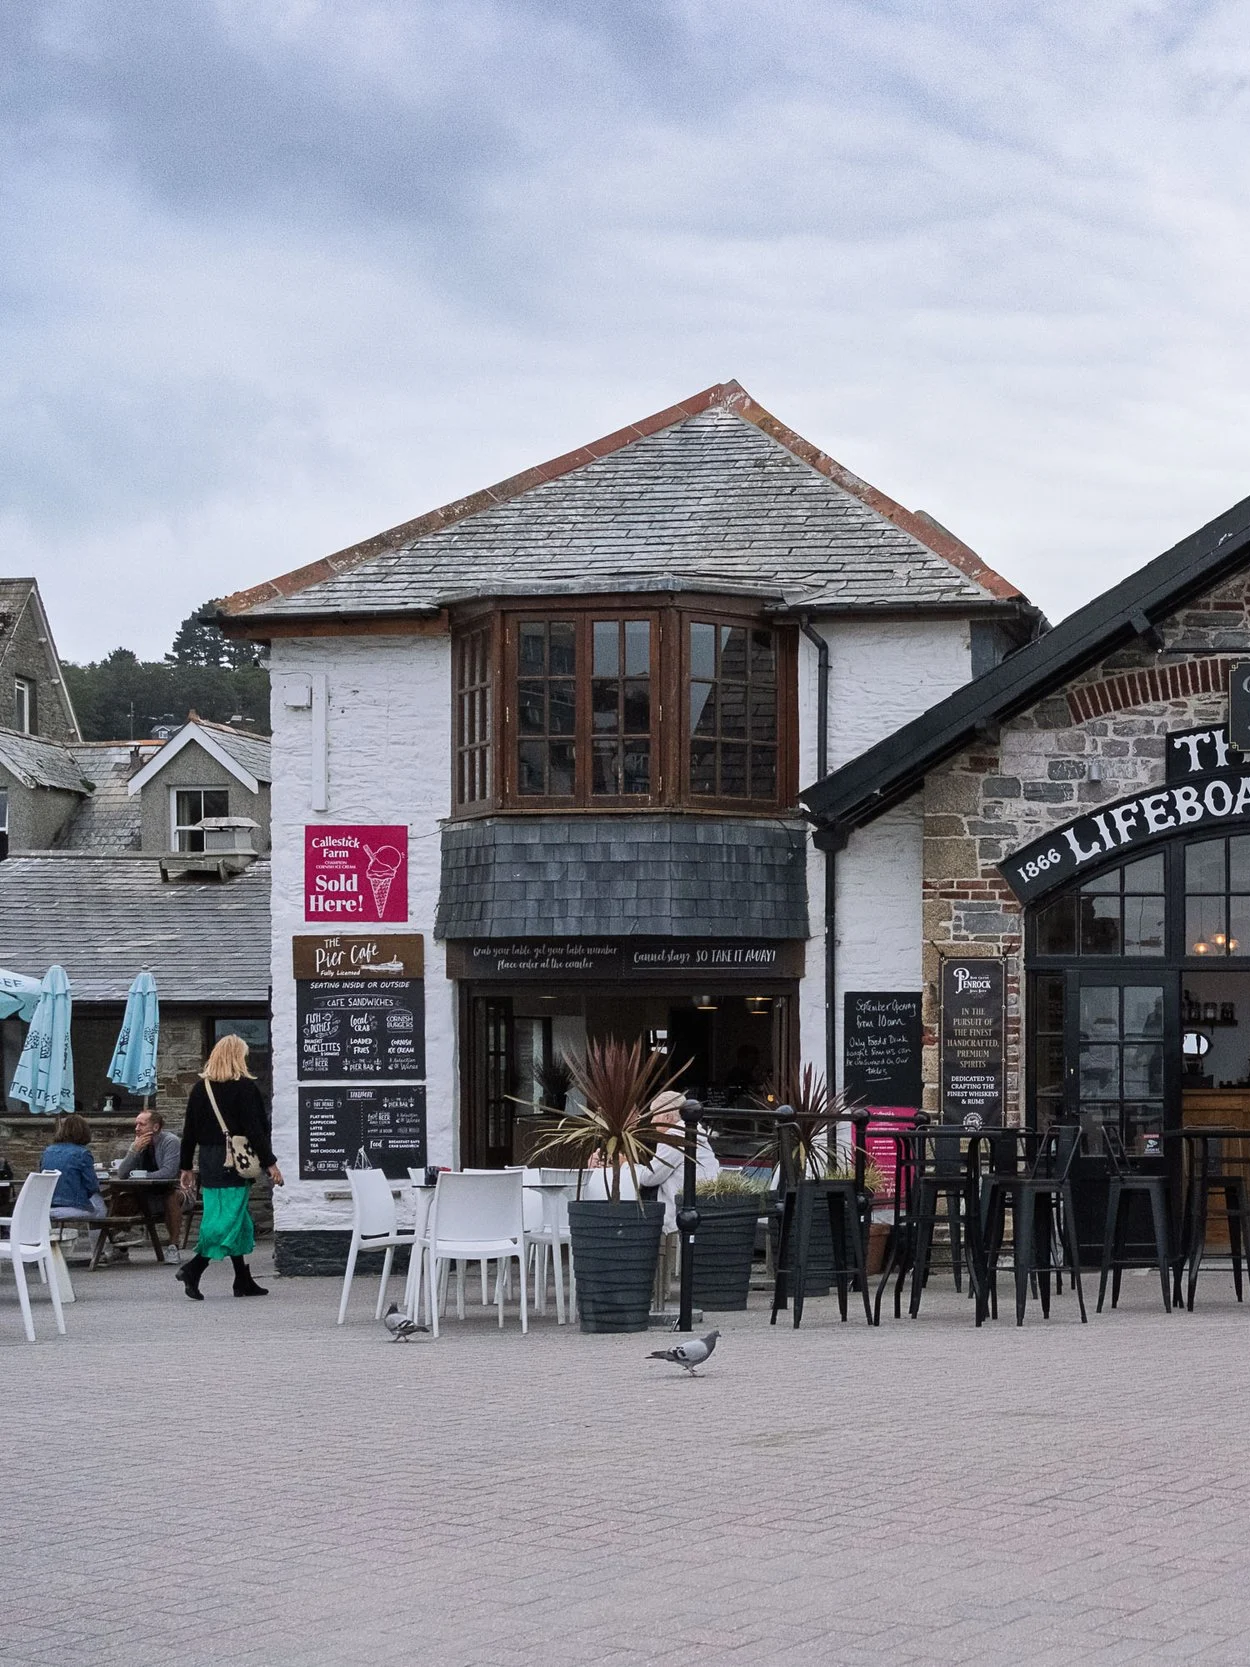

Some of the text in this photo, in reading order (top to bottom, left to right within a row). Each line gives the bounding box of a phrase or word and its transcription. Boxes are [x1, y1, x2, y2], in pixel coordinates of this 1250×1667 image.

[311, 835, 360, 849] Callestick
[322, 848, 349, 858] Farm
[1016, 848, 1062, 884] 1866
[315, 873, 358, 892] Sold
[309, 894, 363, 912] Here!
[324, 937, 341, 949] THE
[473, 945, 491, 957] Grab
[586, 945, 618, 955] number
[695, 950, 708, 963] SO
[711, 949, 732, 963] TAKE
[734, 949, 744, 963] IT
[744, 949, 776, 963] AWAY!
[315, 948, 346, 972] Pier
[550, 957, 563, 969] the
[565, 957, 594, 969] counter
[310, 981, 340, 989] SEATING
[342, 981, 365, 989] INSIDE
[953, 967, 991, 994] PENROCK
[327, 998, 394, 1007] CAFE SANDWICHES
[961, 1007, 986, 1016] IN THE
[305, 1013, 321, 1025] FISH
[952, 1017, 994, 1026] PURSUIT OF
[310, 1021, 331, 1034] DISHES
[354, 1024, 370, 1032] CRAB
[953, 1028, 993, 1037] THE FINEST
[303, 1042, 341, 1053] OMELETTES
[947, 1039, 1000, 1048] HANDCRAFTED,
[353, 1046, 370, 1055] FRIES
[956, 1049, 990, 1058] PREMIUM
[362, 1063, 375, 1071] BAR
[959, 1060, 987, 1069] SPIRITS
